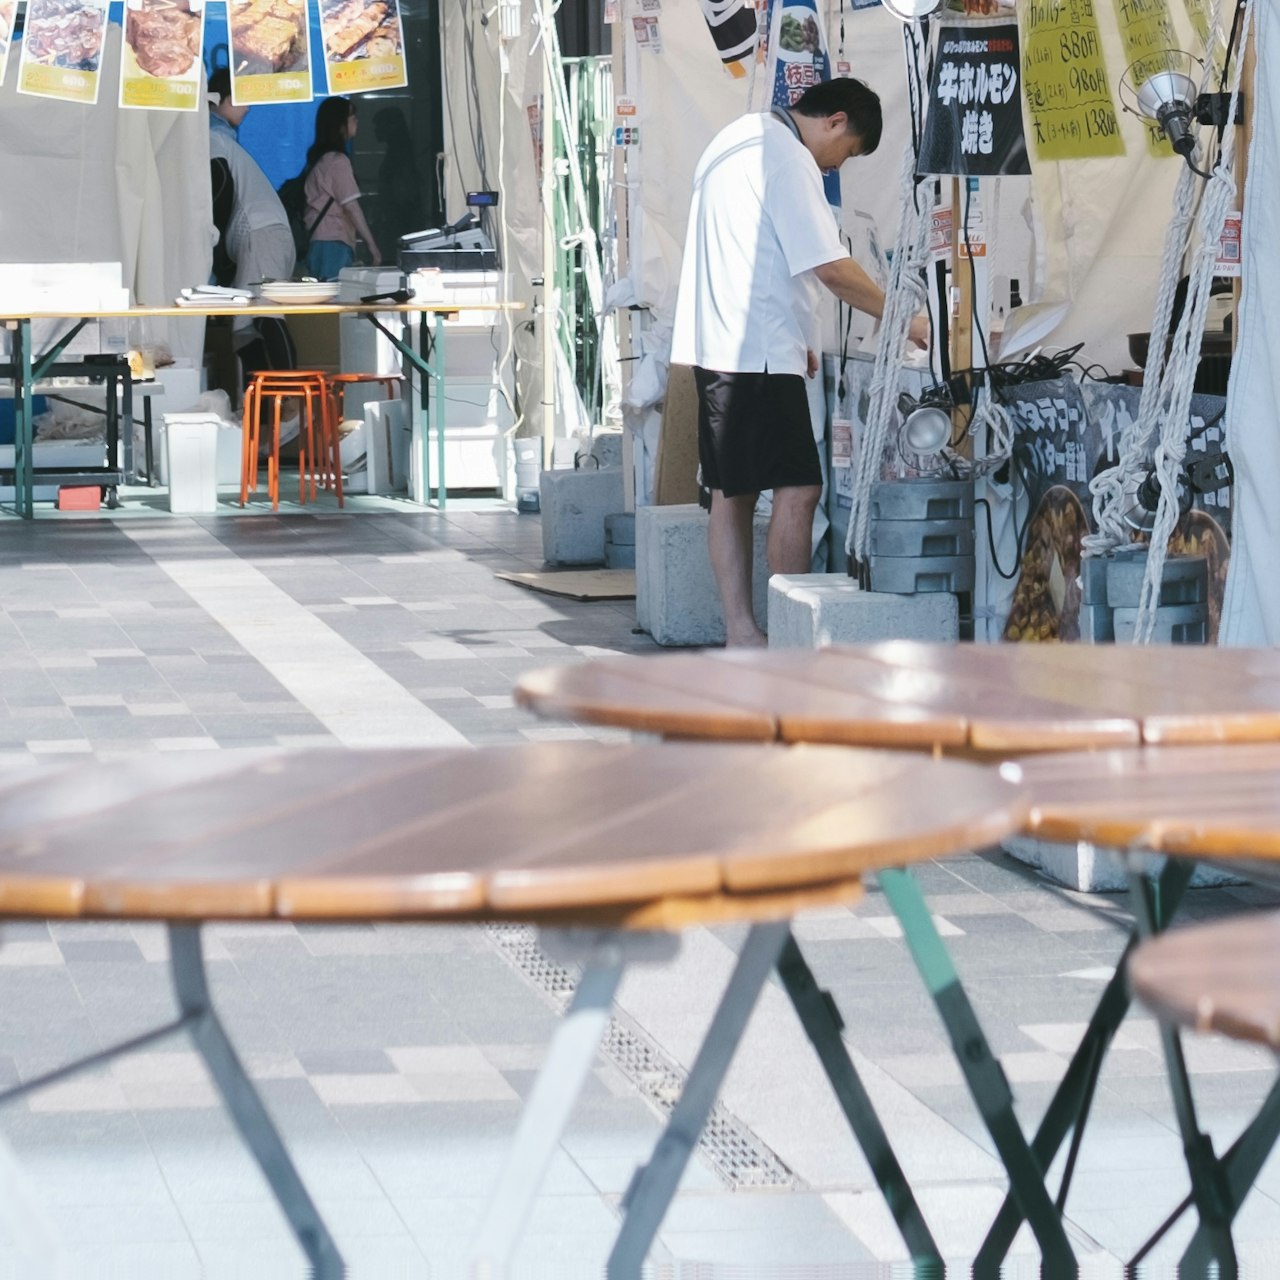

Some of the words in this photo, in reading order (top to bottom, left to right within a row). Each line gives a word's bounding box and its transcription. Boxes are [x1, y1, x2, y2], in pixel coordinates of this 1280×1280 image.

[1059, 30, 1099, 63] 880円
[937, 61, 1018, 106] 牛ホルモン
[1070, 66, 1108, 97] 980円
[960, 109, 994, 155] 焼き
